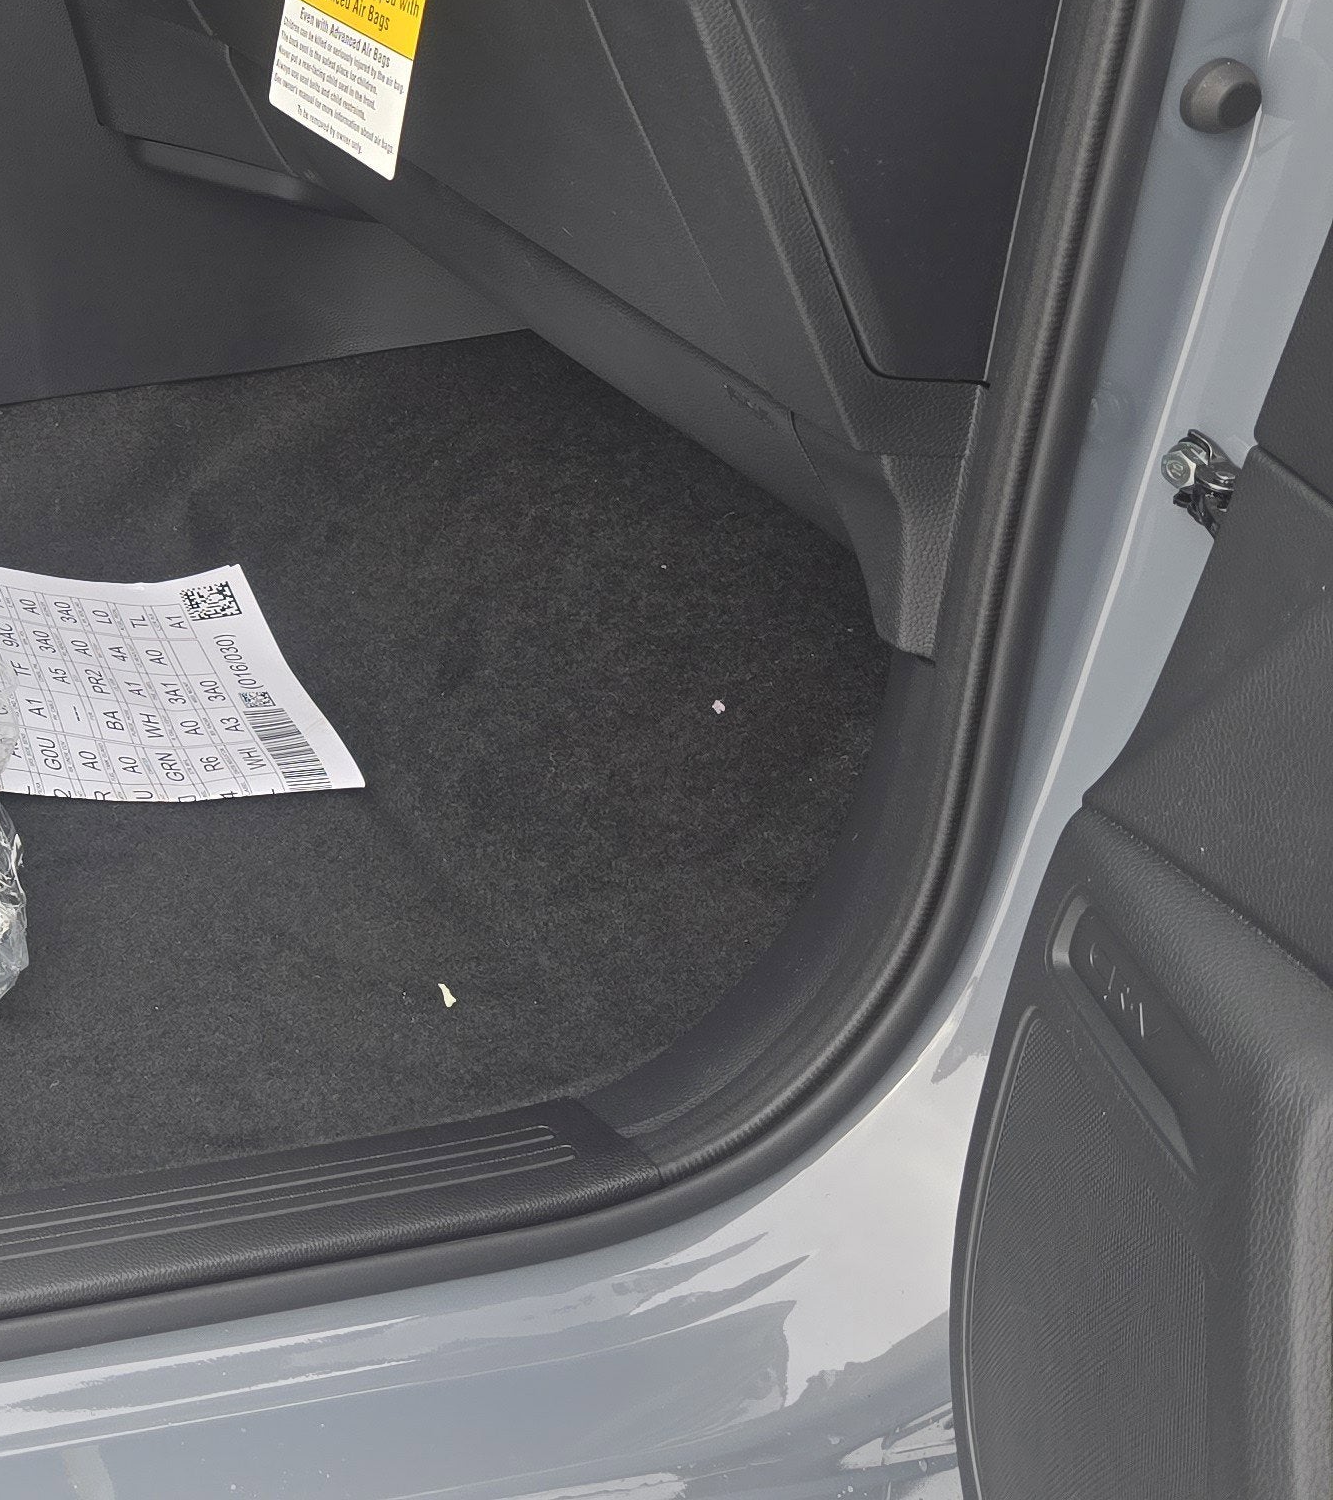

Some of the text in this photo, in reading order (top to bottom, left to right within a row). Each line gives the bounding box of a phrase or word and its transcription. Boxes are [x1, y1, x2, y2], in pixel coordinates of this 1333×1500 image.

[368, 5, 390, 32] Bags
[300, 7, 391, 68] Even with Advanced Air Bags
[129, 615, 148, 628] TL
[165, 616, 188, 629] A1
[109, 646, 128, 661] 4A
[213, 634, 264, 689] (016/030)
[10, 661, 31, 676] TF
[49, 667, 70, 684] A5
[85, 669, 111, 694] PR2
[124, 681, 147, 698] A1
[161, 683, 186, 704] 3A1
[26, 699, 47, 718] A1
[103, 711, 124, 731] BA
[139, 713, 164, 738] WH
[220, 717, 244, 732] A3
[155, 753, 184, 782] GRN
[200, 757, 224, 772] R6
[238, 747, 266, 770] WHI
